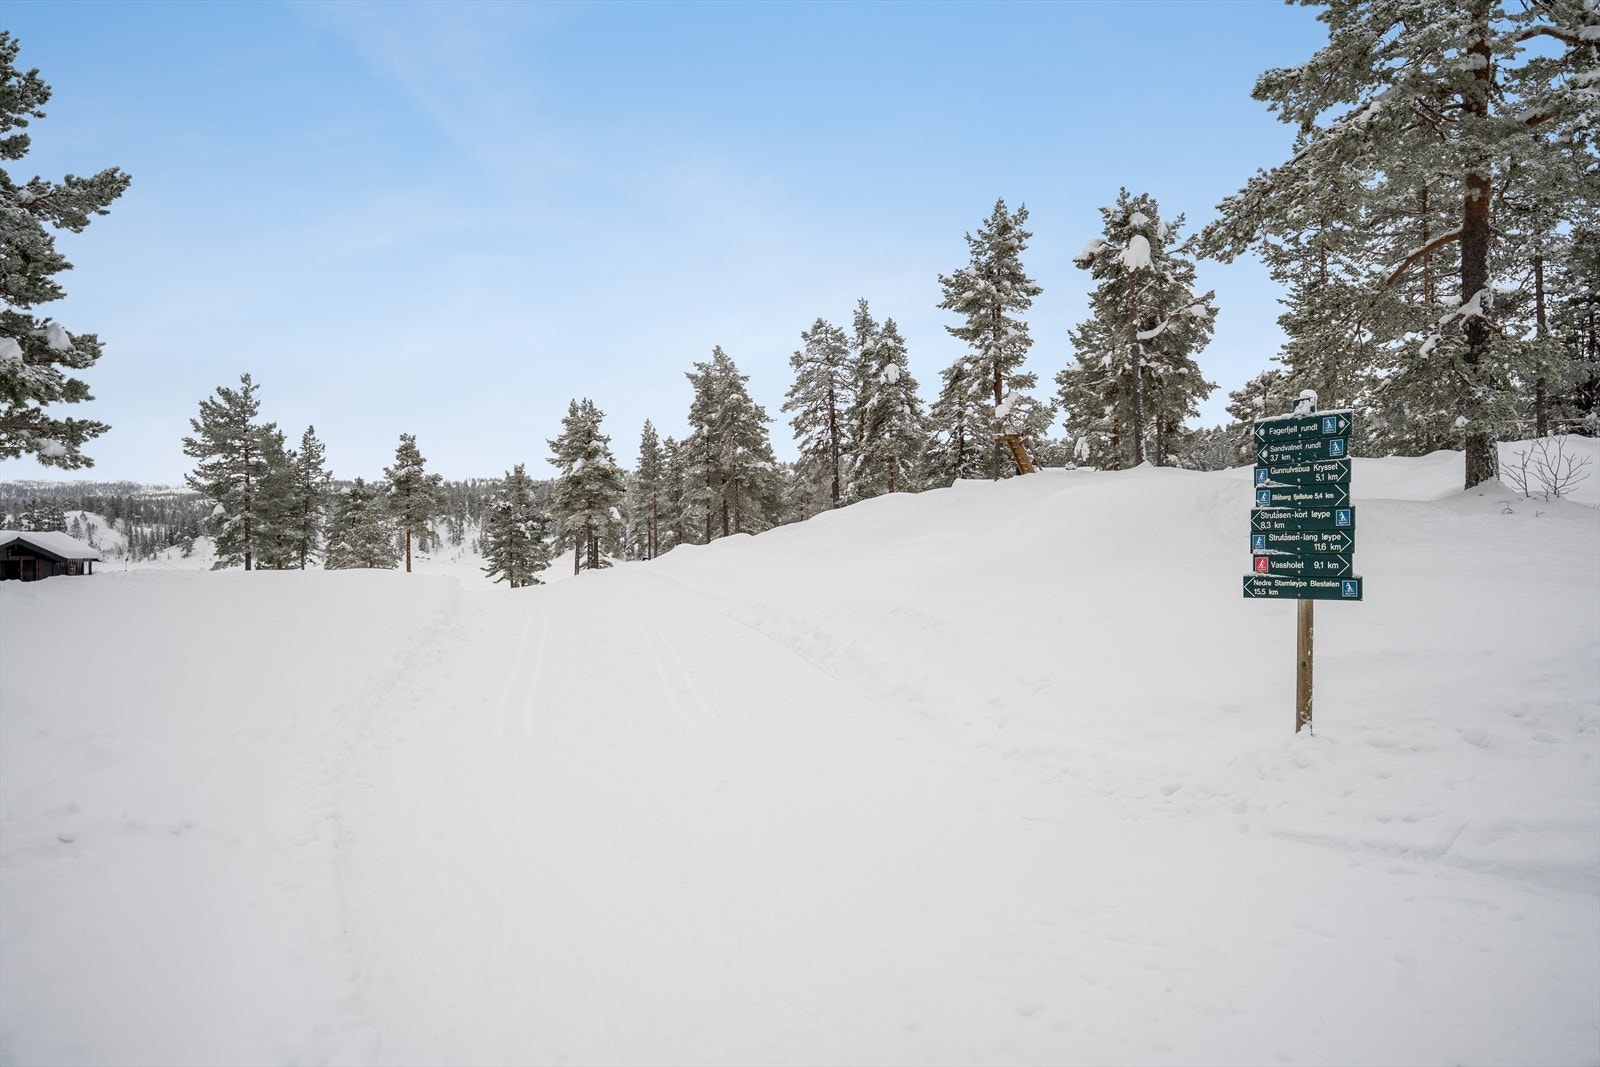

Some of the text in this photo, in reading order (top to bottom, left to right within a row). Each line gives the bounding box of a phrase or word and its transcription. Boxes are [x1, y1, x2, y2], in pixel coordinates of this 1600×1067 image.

[1269, 425, 1297, 435] Fagerfjell
[1300, 423, 1318, 432] rundt
[1270, 444, 1302, 452] Sandvatnet
[1313, 463, 1338, 472] Krysset
[1315, 473, 1325, 482] 5,1
[1260, 511, 1308, 519] Strutåsen-kort
[1268, 532, 1342, 541] Strutåsen-lang løype
[1314, 543, 1327, 551] 11,6
[1270, 561, 1339, 569] Vassholet 9,1 km
[1274, 580, 1307, 588] Stamløype
[1310, 580, 1340, 588] Blestølen
